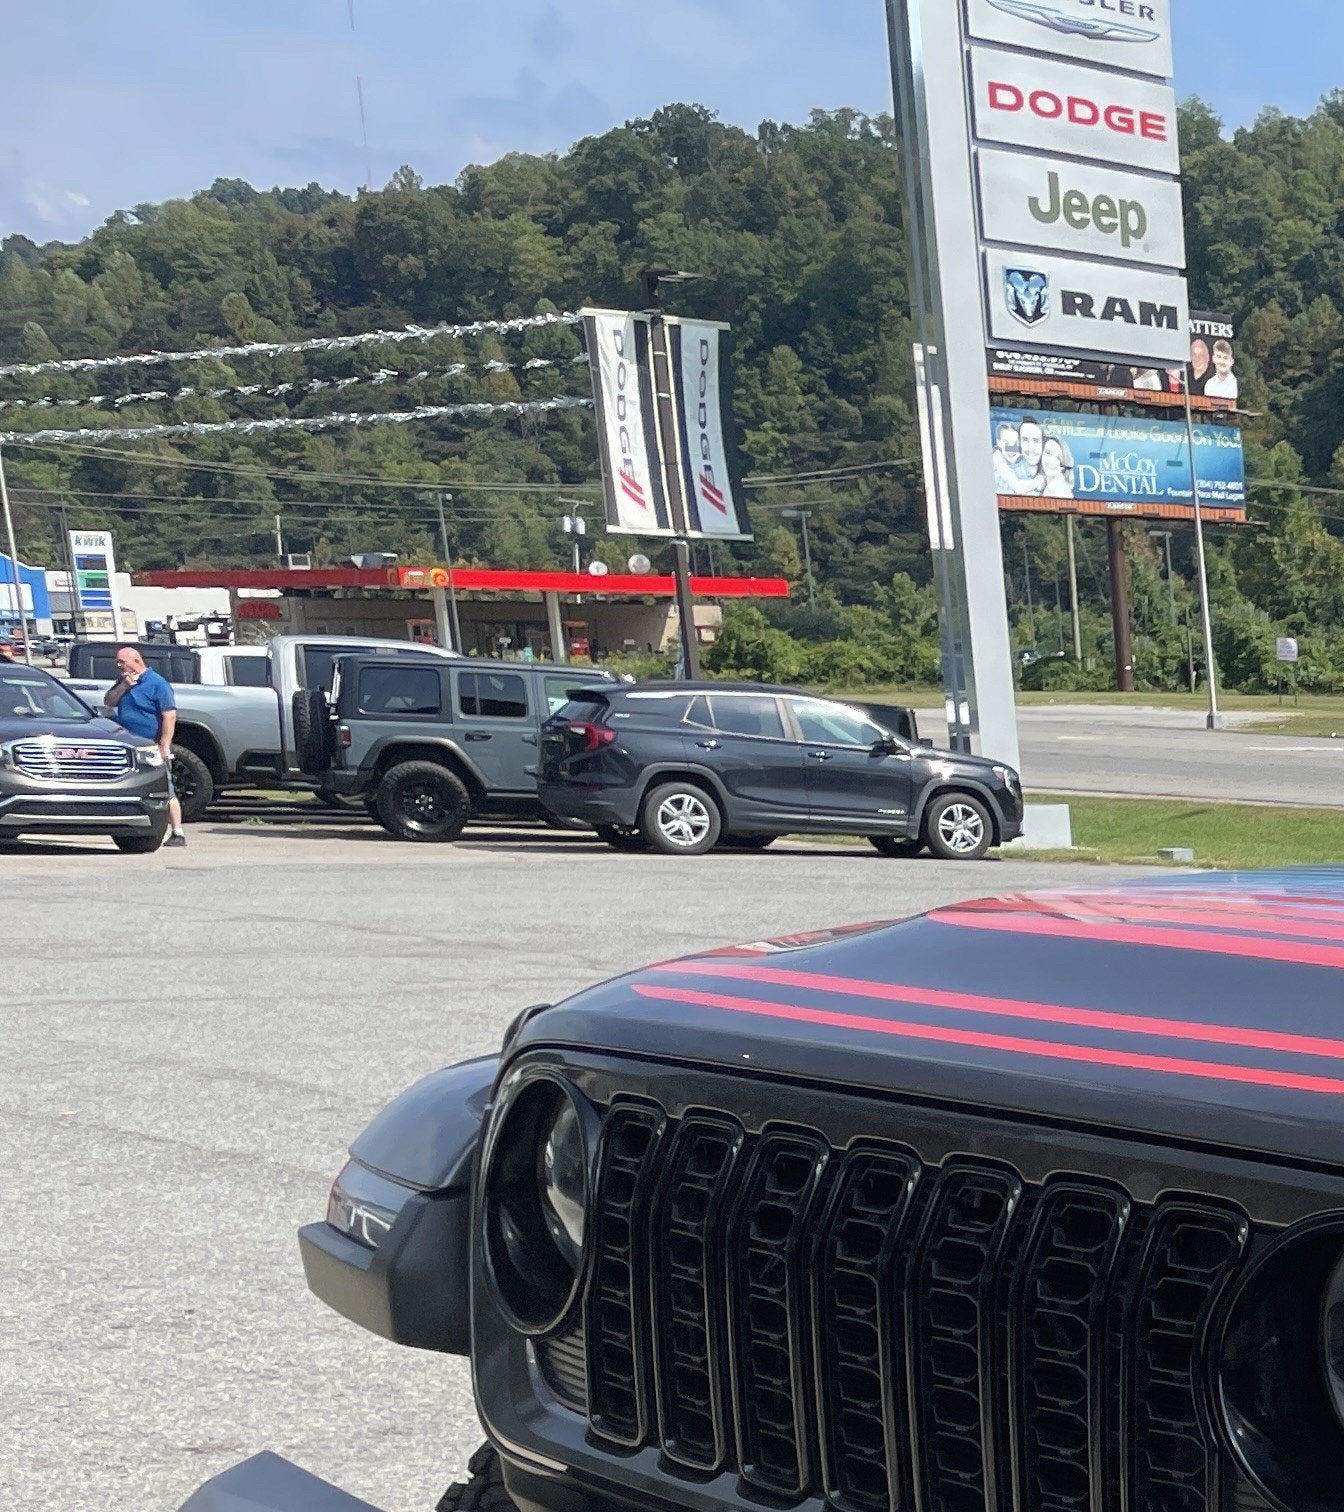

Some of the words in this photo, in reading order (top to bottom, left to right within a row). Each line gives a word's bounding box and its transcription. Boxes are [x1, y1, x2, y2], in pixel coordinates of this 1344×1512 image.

[988, 81, 1167, 142] DODGE
[1027, 170, 1147, 248] Jeep
[1060, 289, 1178, 331] RAM
[1188, 318, 1234, 338] ATTERS
[613, 329, 636, 483] DODGE
[698, 338, 716, 491] DODGE
[1077, 464, 1164, 495] DENTAL
